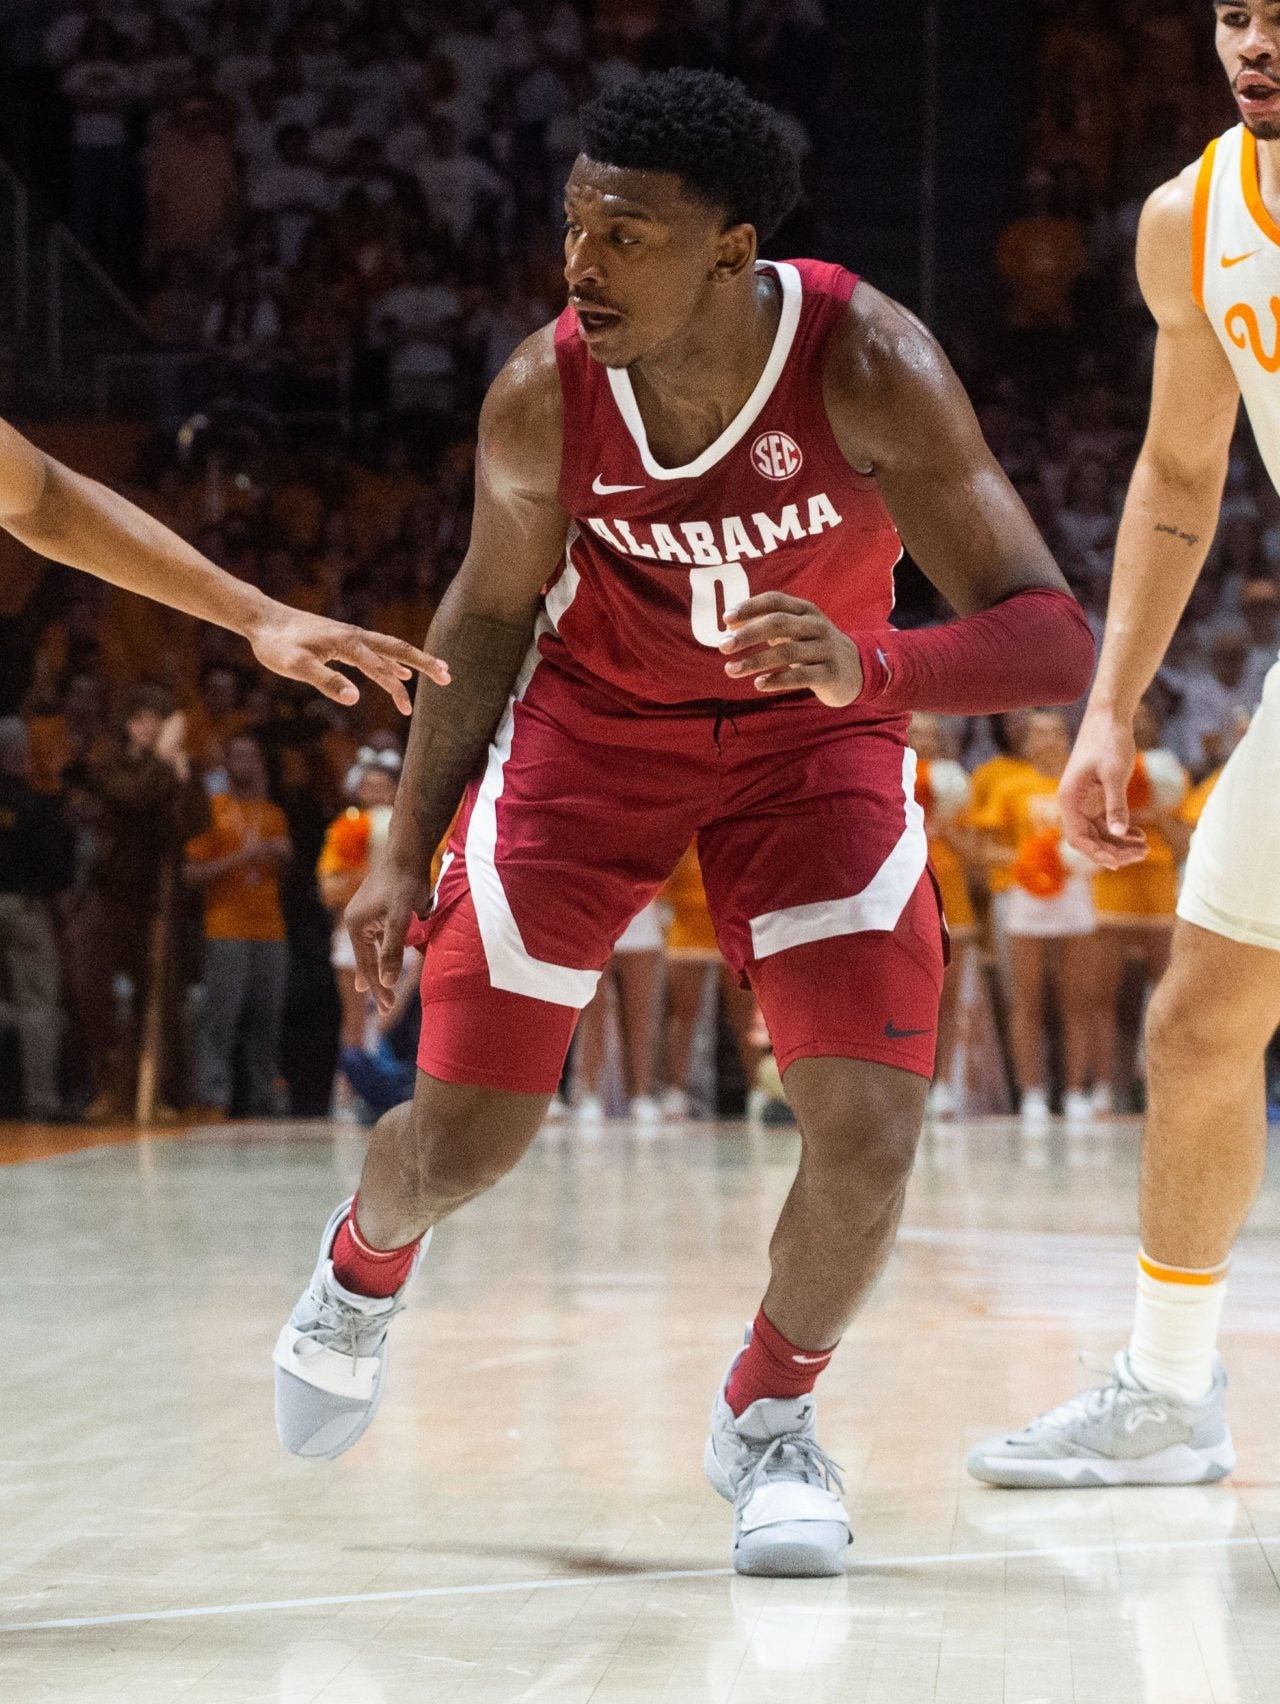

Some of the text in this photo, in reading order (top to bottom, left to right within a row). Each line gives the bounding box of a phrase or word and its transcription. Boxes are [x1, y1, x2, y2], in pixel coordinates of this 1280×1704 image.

[754, 433, 801, 478] SEC
[587, 493, 843, 565] ALABAMA
[689, 562, 751, 648] 0
